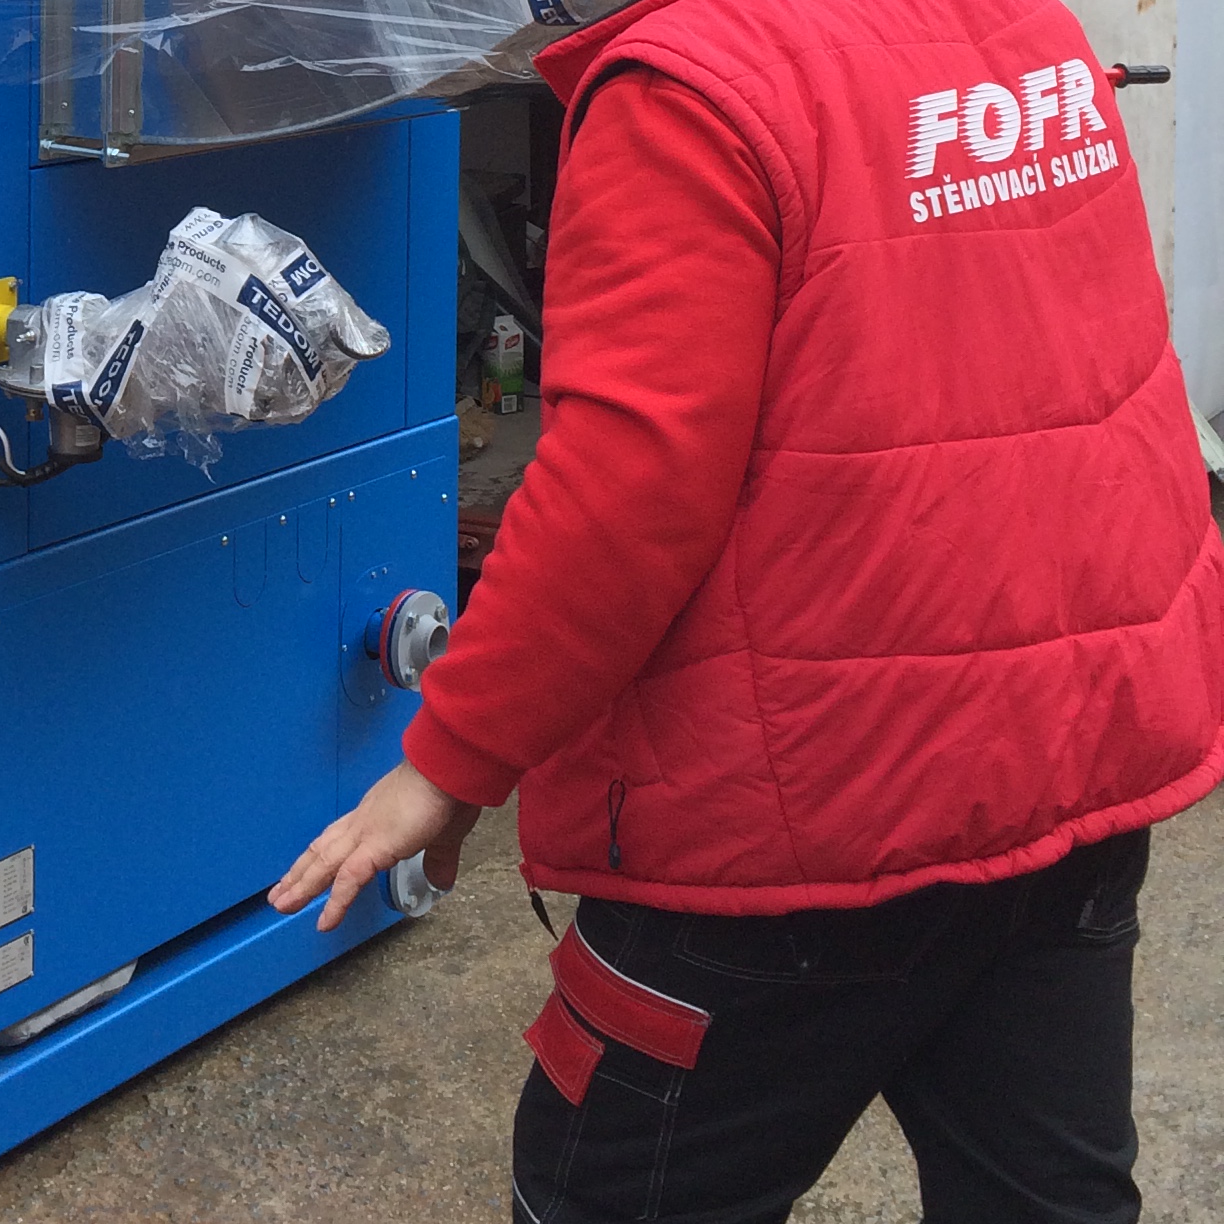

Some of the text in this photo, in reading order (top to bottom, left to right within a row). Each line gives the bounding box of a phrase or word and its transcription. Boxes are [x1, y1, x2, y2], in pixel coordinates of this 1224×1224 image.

[904, 58, 1107, 179] FOFR
[909, 137, 1119, 223] STĚHOVACÍ SLUŽBA
[178, 240, 227, 273] Products
[191, 220, 224, 240] Genu
[251, 286, 320, 370] TEDOM
